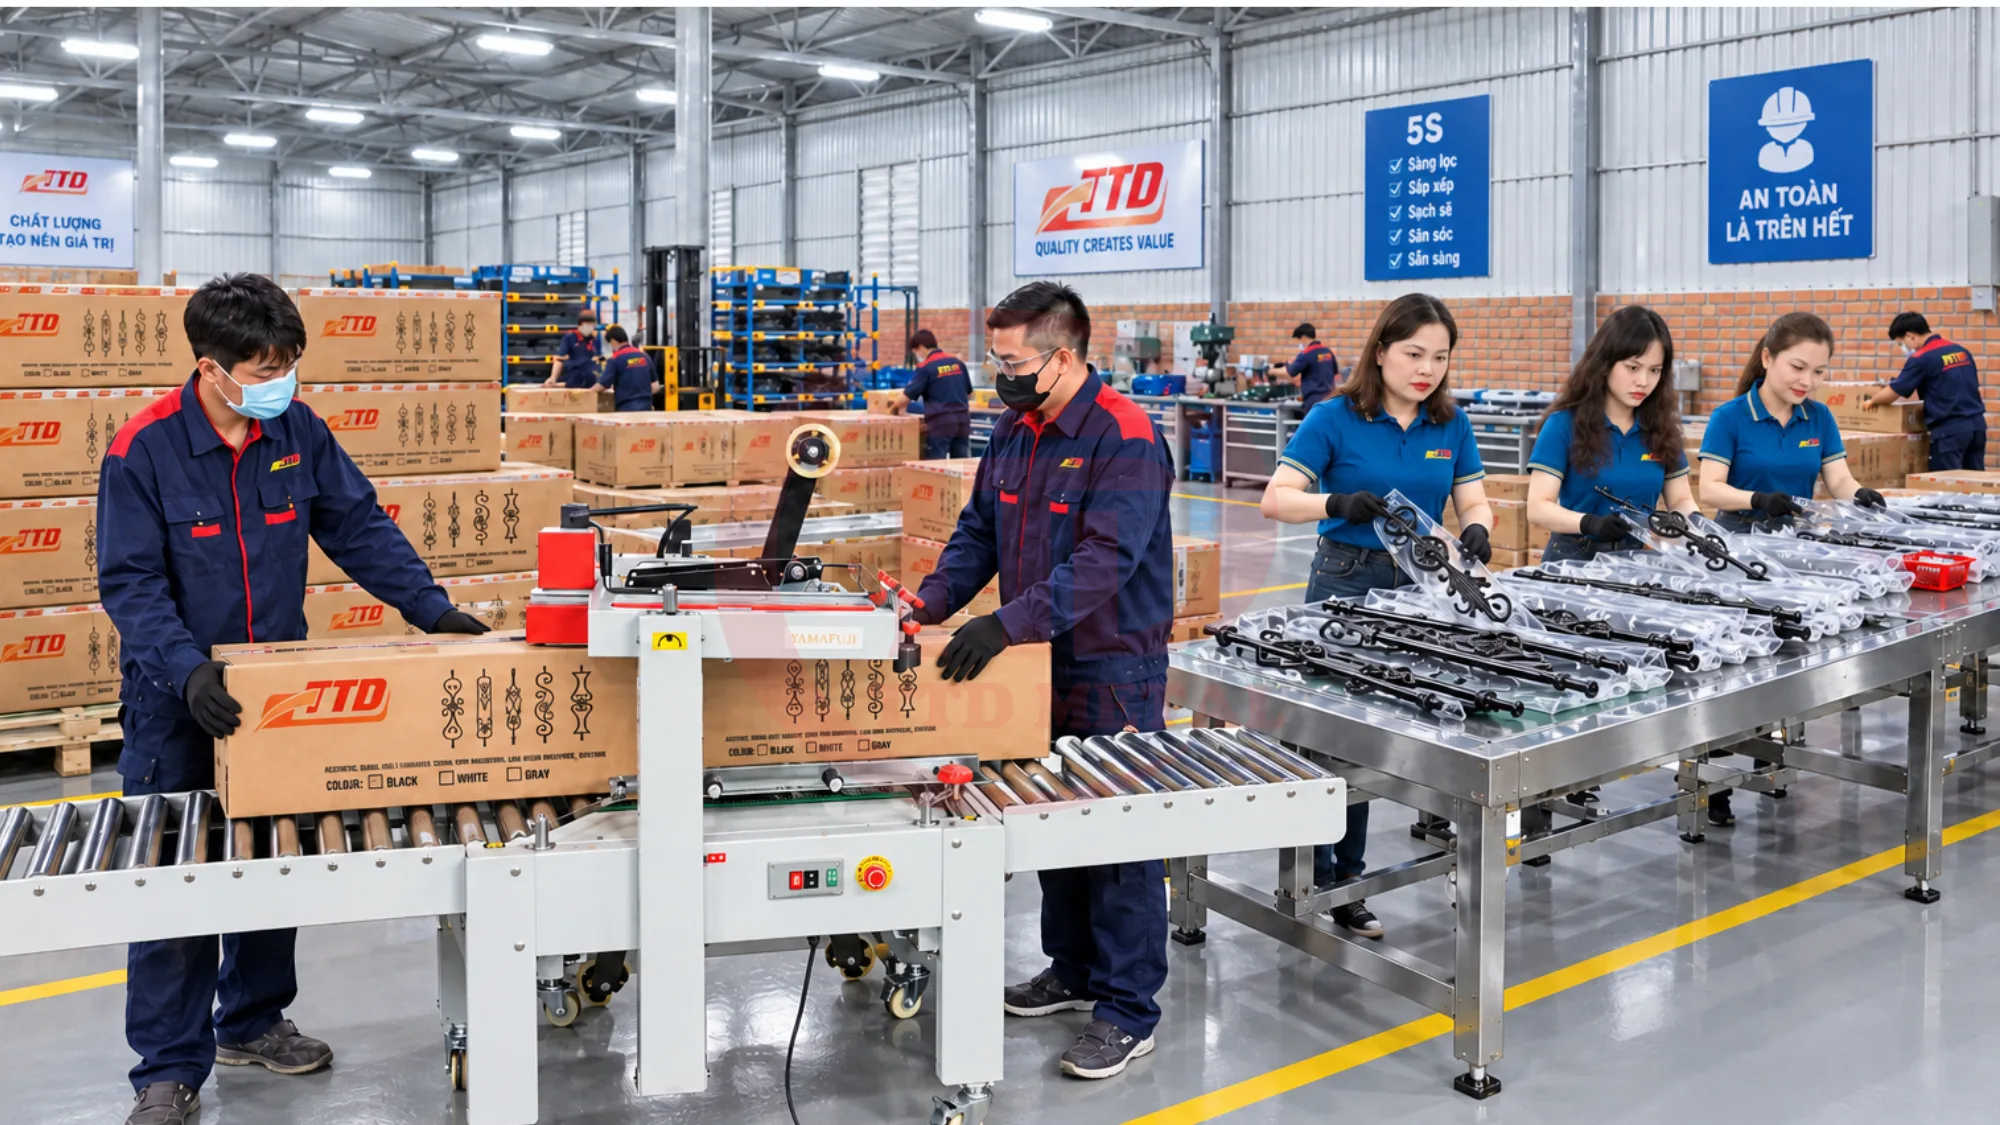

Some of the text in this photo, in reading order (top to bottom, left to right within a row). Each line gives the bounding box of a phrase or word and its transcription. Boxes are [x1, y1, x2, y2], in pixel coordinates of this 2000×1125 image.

[1406, 112, 1444, 145] 5S
[1408, 153, 1458, 173] Sàng lọc
[1739, 179, 1837, 210] AN TOÀN
[1726, 207, 1853, 242] LÀ TRÊN HẾT
[65, 234, 88, 248] GIÁ
[92, 237, 114, 253] TRỊ
[1035, 232, 1174, 257] QUALITY CREATES VALUE
[791, 633, 856, 645] YAMAFUJI
[386, 776, 418, 788] BLACK
[457, 772, 488, 784] WHITE
[525, 769, 550, 780] GRAY
